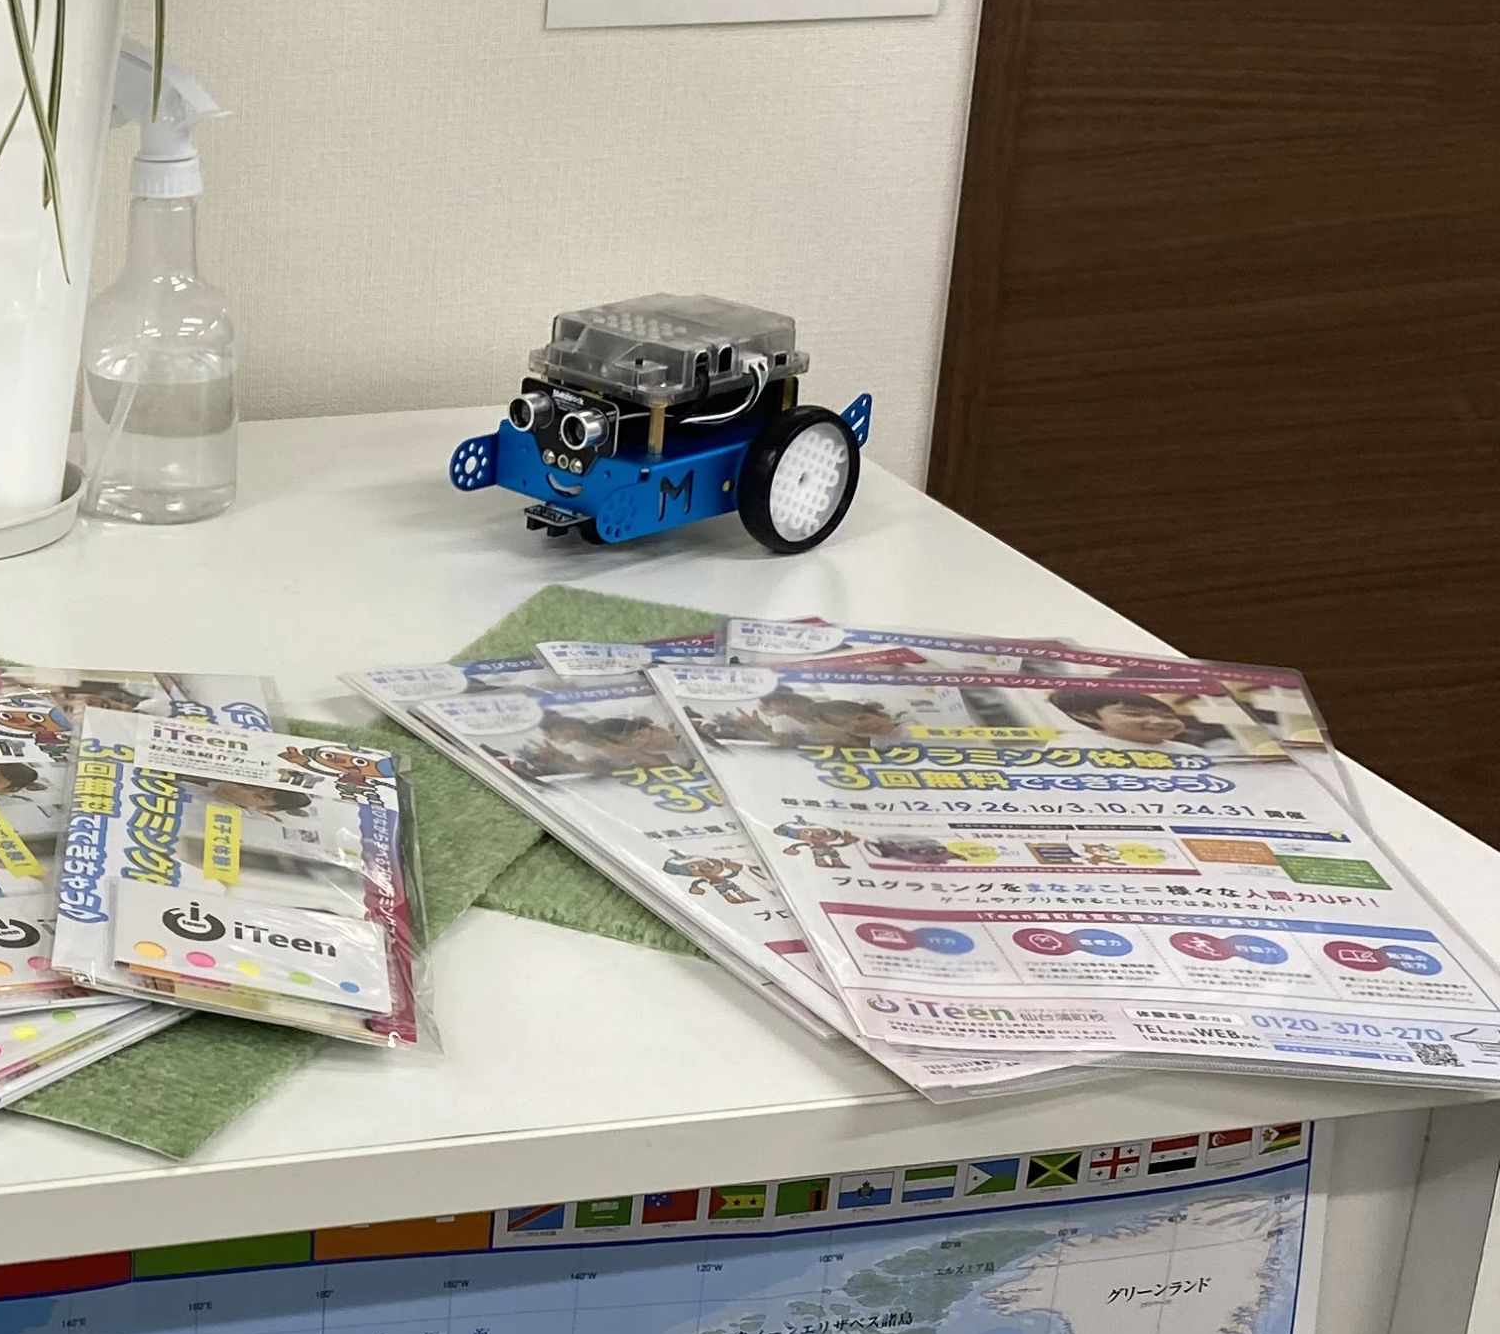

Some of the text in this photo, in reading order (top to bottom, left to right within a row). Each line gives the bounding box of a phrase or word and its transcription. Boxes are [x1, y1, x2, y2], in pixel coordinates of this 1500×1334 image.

[151, 726, 250, 752] iTeen
[233, 919, 338, 958] iTeen
[905, 997, 1016, 1022] iTeen
[1252, 1014, 1445, 1042] 0120-370-270
[1106, 1277, 1213, 1305] グリーンランド
